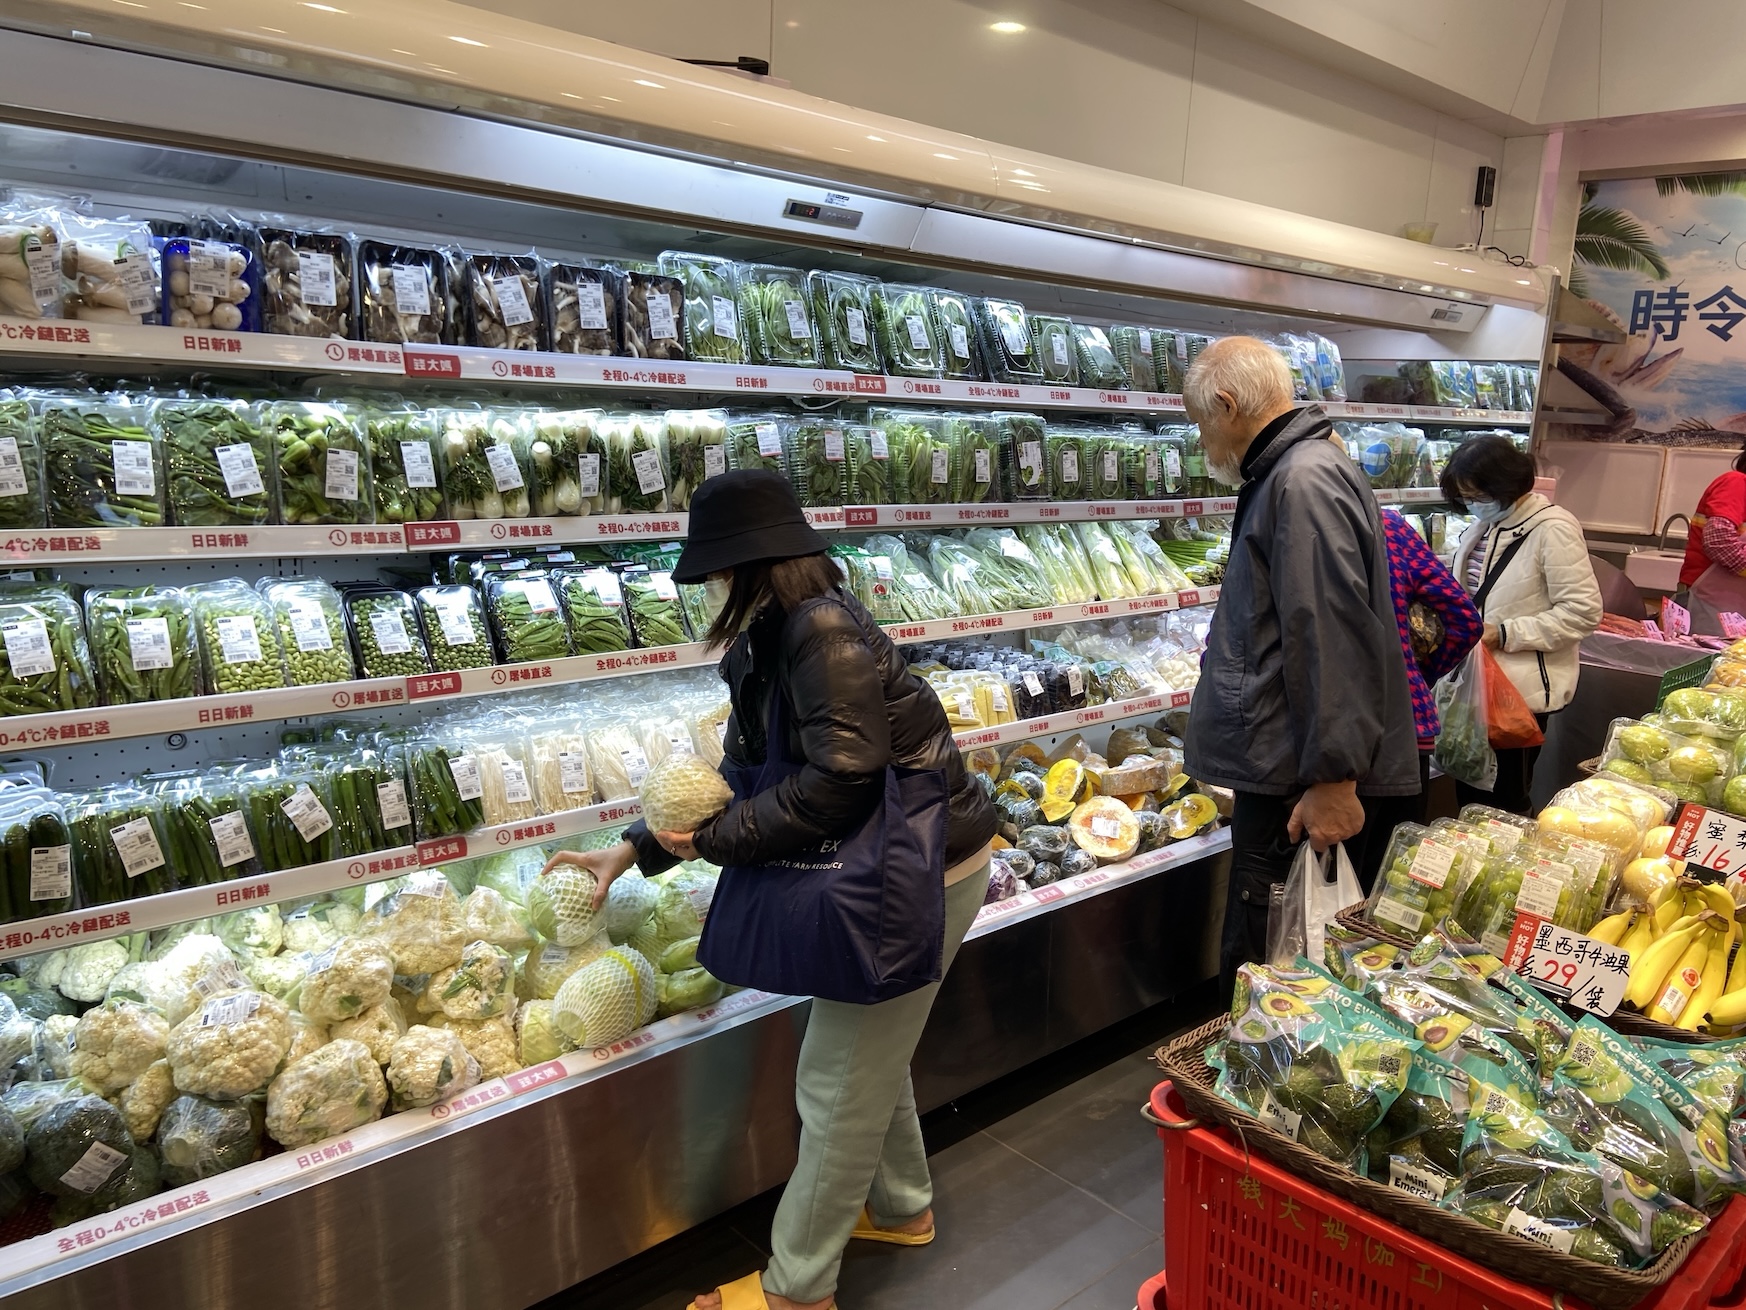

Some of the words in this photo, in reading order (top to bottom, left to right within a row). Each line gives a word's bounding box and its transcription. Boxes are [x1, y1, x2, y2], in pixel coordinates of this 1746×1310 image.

[1629, 285, 1746, 342] 時令
[0, 323, 90, 343] ℃冷鏈配送
[184, 335, 242, 353] 日日新鮮
[735, 376, 768, 389] 日日新鮮
[191, 534, 249, 548] 日日新鮮
[198, 704, 254, 723] 日日新鮮
[1687, 811, 1700, 819] HOT
[216, 883, 271, 906] 日日新鮮
[0, 911, 131, 951] 程0-4℃冷鏈配送
[1519, 923, 1535, 932] HOT
[1533, 925, 1630, 977] 墨西哥牛油果
[1494, 971, 1525, 996] AVO
[1323, 988, 1353, 1008] AVO
[1466, 1028, 1501, 1050] AVO
[1587, 1026, 1622, 1053] AVO
[1621, 1051, 1705, 1126] EVERYDAY
[296, 1139, 354, 1170] 日日新鮮
[1404, 1172, 1428, 1189] Mini
